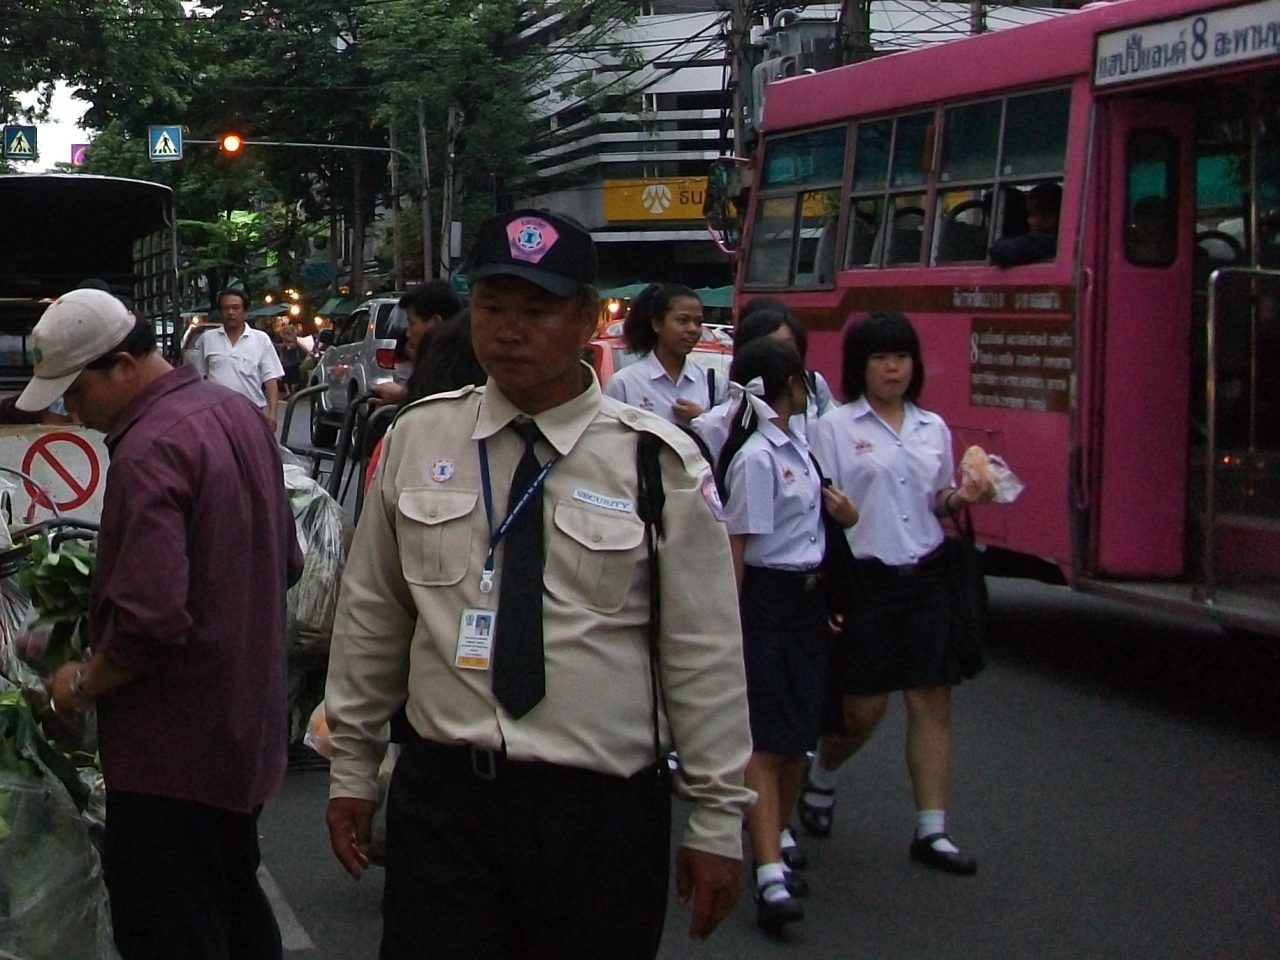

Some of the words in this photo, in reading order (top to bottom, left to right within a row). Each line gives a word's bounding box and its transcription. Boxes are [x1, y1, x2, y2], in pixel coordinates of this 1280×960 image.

[1191, 17, 1208, 61] 8
[971, 332, 979, 364] 8
[577, 490, 629, 508] SECURITY
